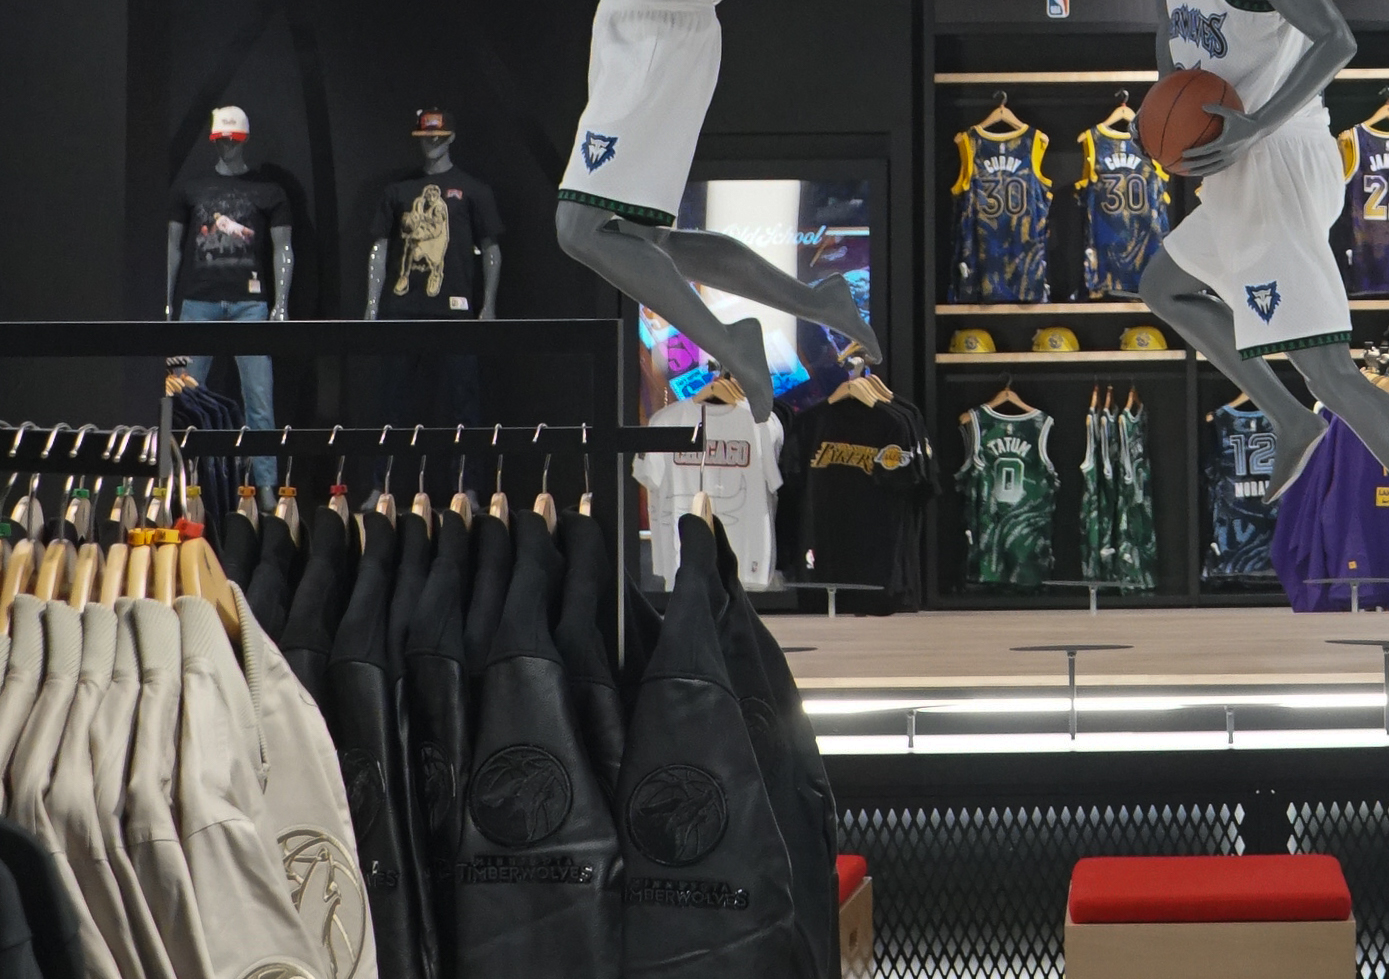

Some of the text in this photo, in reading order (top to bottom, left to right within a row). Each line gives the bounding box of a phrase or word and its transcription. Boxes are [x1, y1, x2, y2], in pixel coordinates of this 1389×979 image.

[983, 155, 1022, 173] CURRY
[1104, 153, 1142, 171] CURRY
[979, 176, 1028, 218] 30
[1101, 173, 1149, 214] 30
[986, 436, 1032, 458] TATUM
[1229, 432, 1277, 476] 12
[994, 457, 1025, 503] 0
[1235, 480, 1270, 498] MORA
[456, 862, 593, 883] TIMBERWOLVES
[624, 888, 749, 908] IMBERWOLVES
